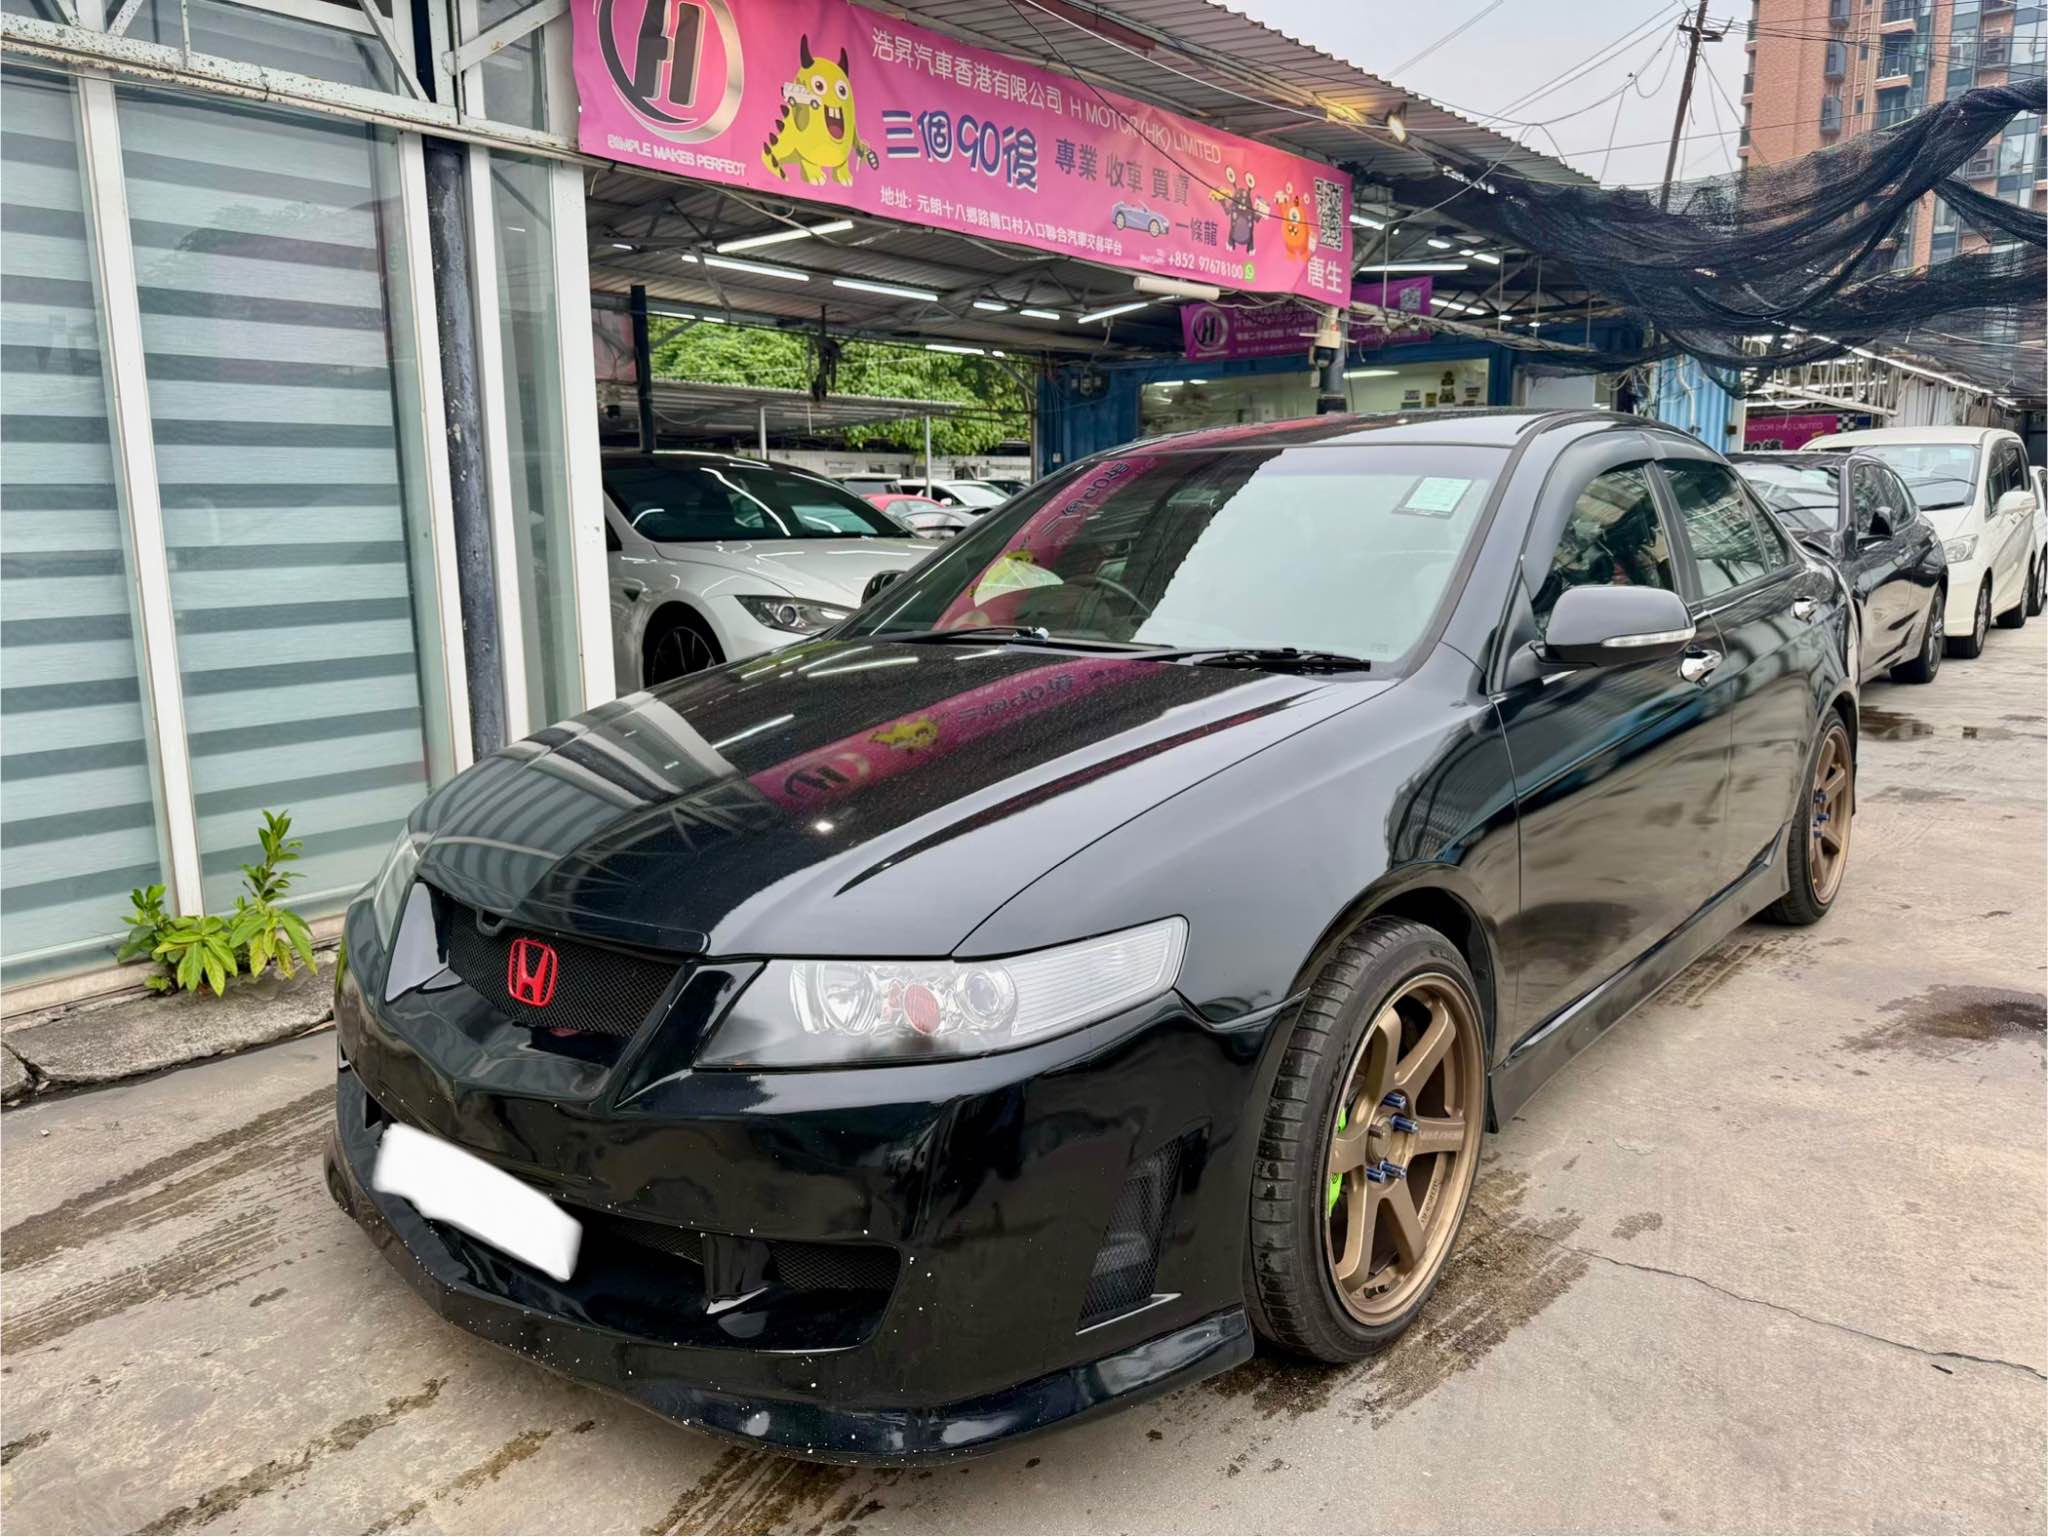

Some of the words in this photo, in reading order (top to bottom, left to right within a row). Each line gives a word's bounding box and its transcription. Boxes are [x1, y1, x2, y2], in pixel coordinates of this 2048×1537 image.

[872, 27, 1063, 115] 浩昇汽車香港有限公司
[881, 110, 1039, 193] 三個90後
[1070, 96, 1082, 120] H
[1085, 102, 1139, 137] MOTOR
[1140, 119, 1171, 151] (HK)
[1173, 131, 1222, 164] LIMITED
[696, 153, 748, 177] PERFECT
[1055, 138, 1098, 182] 專業
[1106, 152, 1144, 193] 收車
[1175, 217, 1219, 247] 一條龍
[1168, 250, 1196, 270] +852
[1199, 256, 1244, 280] 97678100
[1307, 255, 1343, 294] 唐生
